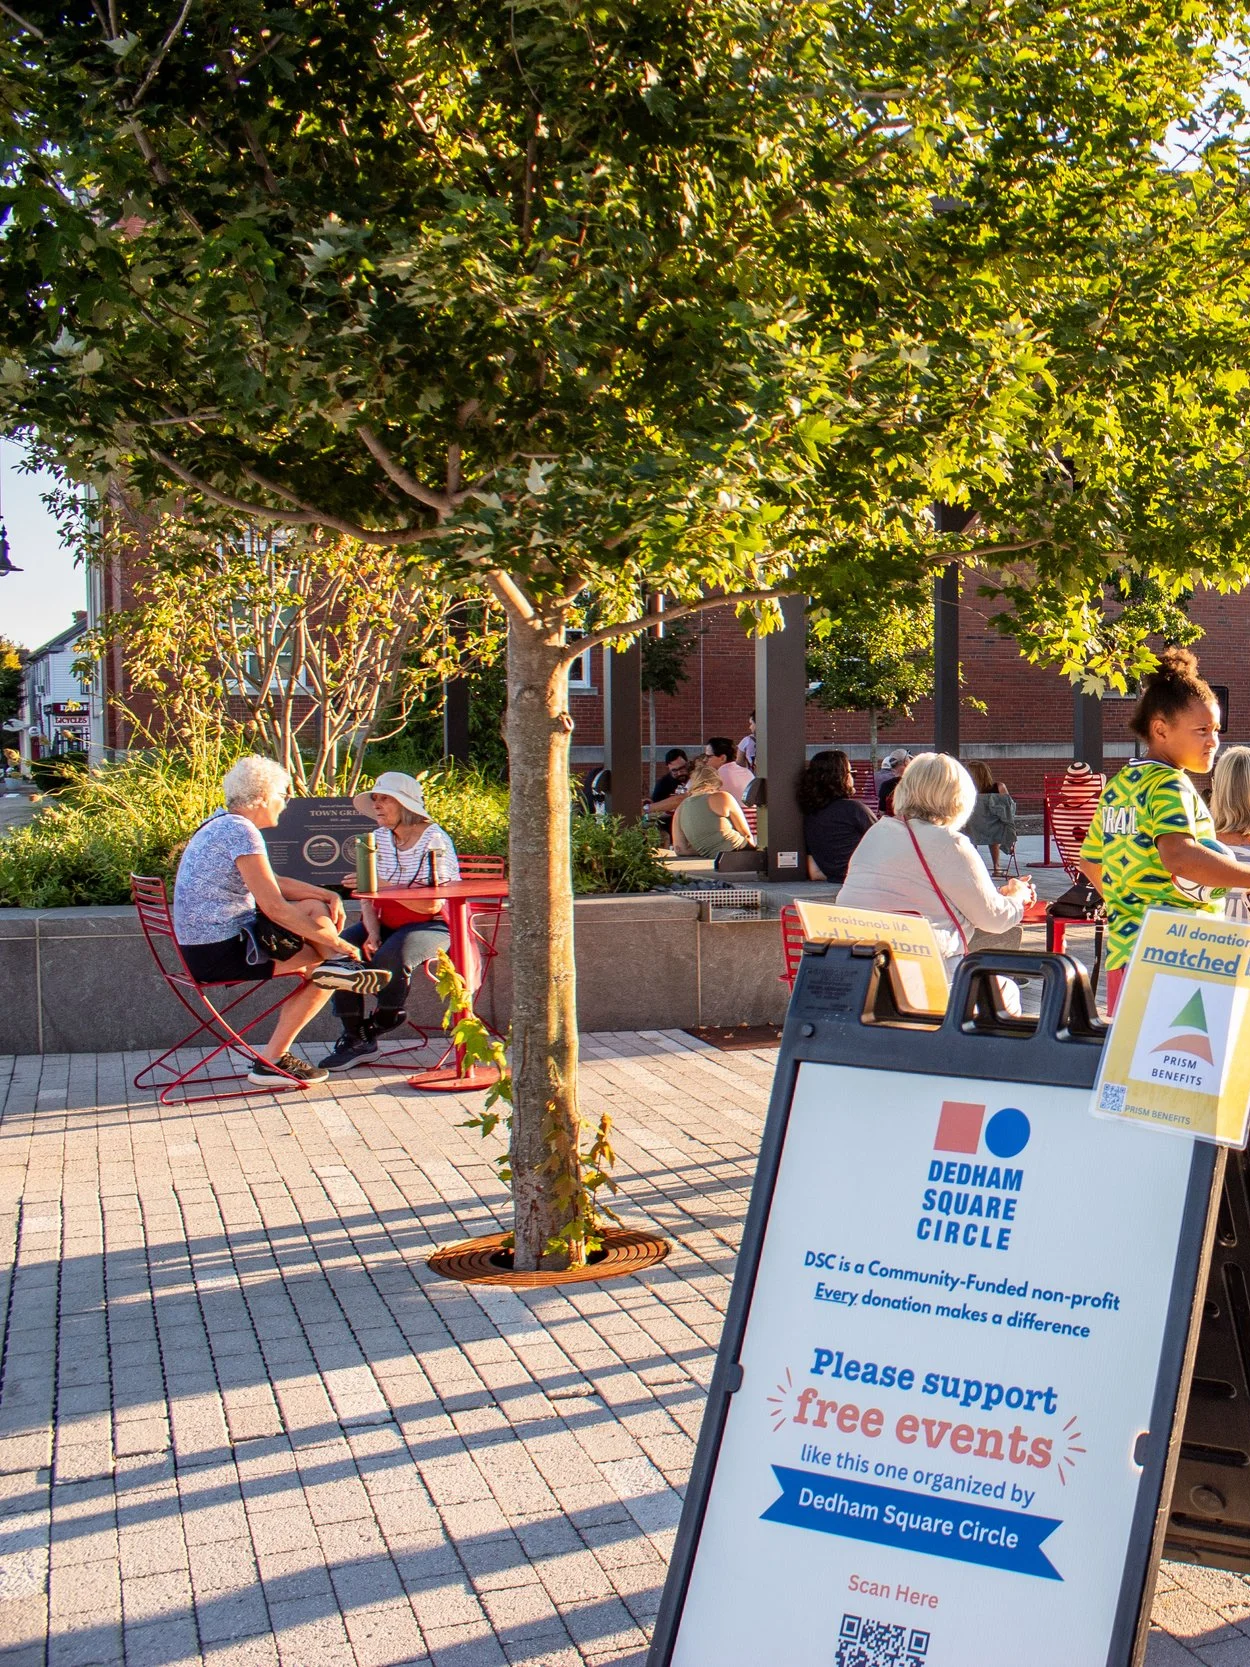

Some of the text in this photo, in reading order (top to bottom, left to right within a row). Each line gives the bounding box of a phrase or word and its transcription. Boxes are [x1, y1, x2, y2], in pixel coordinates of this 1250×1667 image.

[1166, 923, 1187, 937] All
[1142, 946, 1241, 977] matched
[1151, 1068, 1202, 1086] BENEFITS
[1163, 1055, 1198, 1070] PRISM
[1125, 1104, 1191, 1125] PRISM BENEFITS
[928, 1160, 1024, 1191] DEDHAM
[922, 1188, 1017, 1221] SQUARE
[916, 1217, 1011, 1251] CIRCLE
[804, 1251, 1121, 1311] DSC is a Community-Funded non-profit
[814, 1282, 1091, 1338] Every donation makes a difference
[810, 1347, 1059, 1415] Please support
[793, 1387, 1054, 1470] free events
[800, 1443, 1036, 1509] like this one organized by
[798, 1487, 1019, 1549] Dedham Square Circle
[848, 1574, 939, 1610] Scan Here
